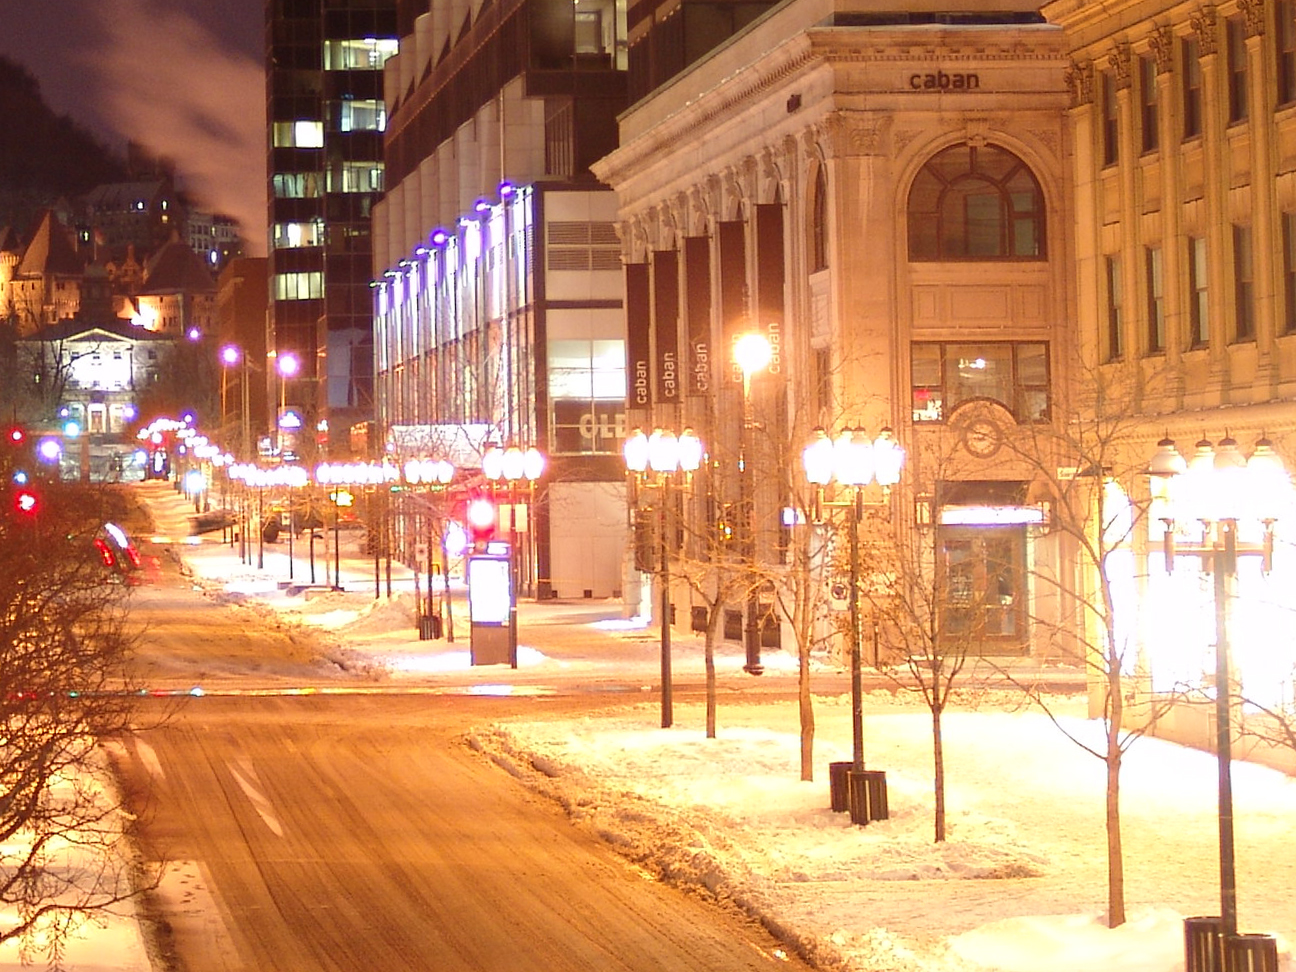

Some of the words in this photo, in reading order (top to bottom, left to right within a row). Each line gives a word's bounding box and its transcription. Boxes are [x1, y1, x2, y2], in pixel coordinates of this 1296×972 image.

[910, 70, 980, 89] caban
[634, 360, 647, 404] caban
[662, 351, 676, 397] caban
[694, 343, 708, 391] caban
